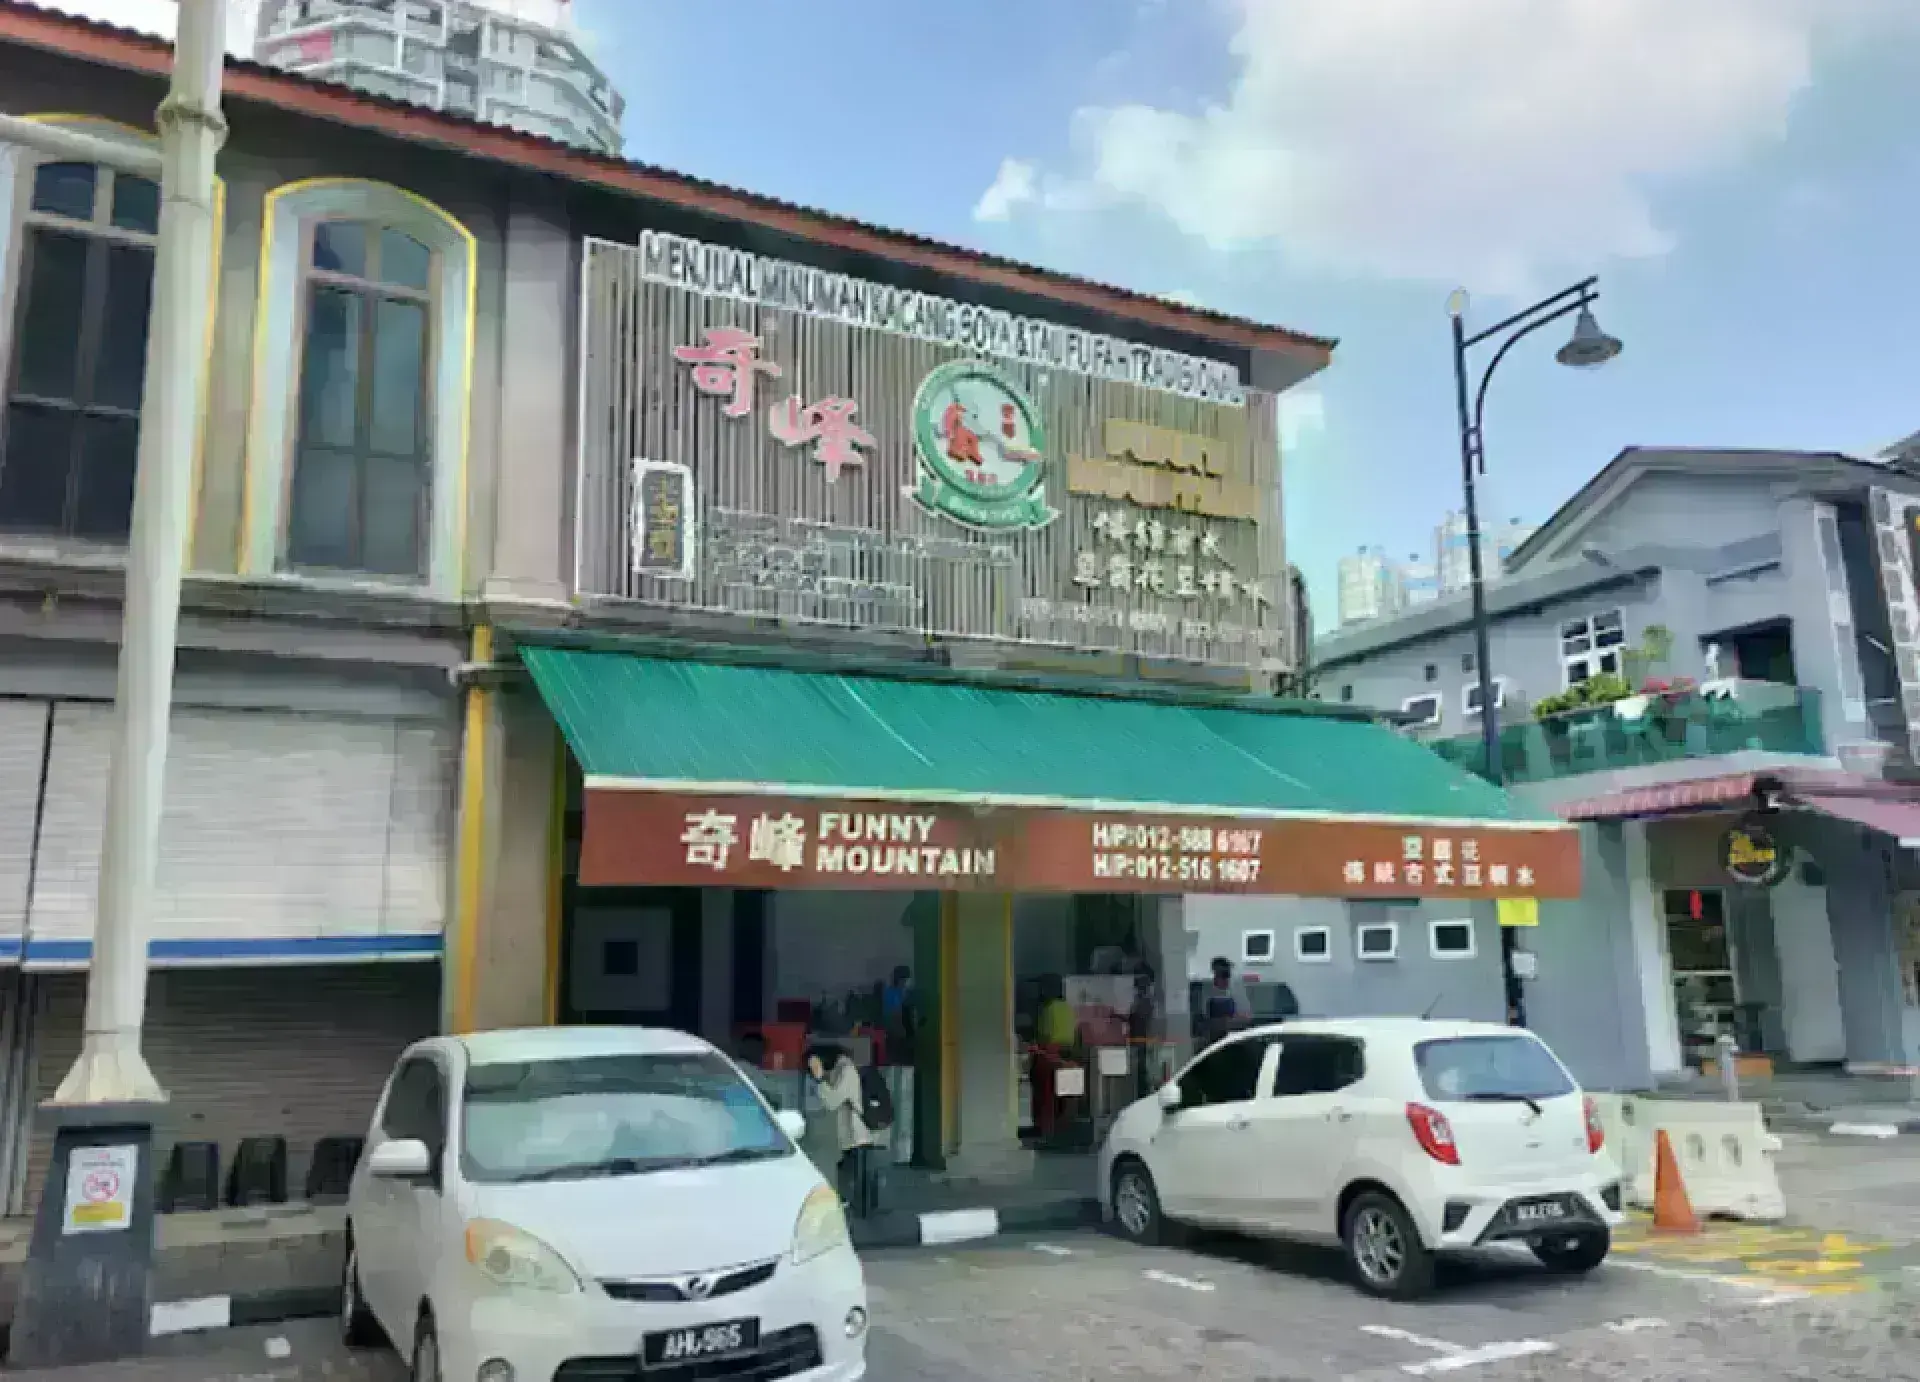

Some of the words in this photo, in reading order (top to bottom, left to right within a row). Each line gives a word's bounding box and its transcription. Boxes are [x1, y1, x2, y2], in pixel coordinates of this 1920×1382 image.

[640, 229, 758, 302] MENJUAL
[760, 256, 866, 326] MINUMAN
[674, 327, 878, 484] 奇峰
[680, 808, 807, 872] 奇峰
[818, 811, 937, 844] FUNNY
[1216, 829, 1262, 855] 67
[816, 844, 995, 875] MOUNTAIN
